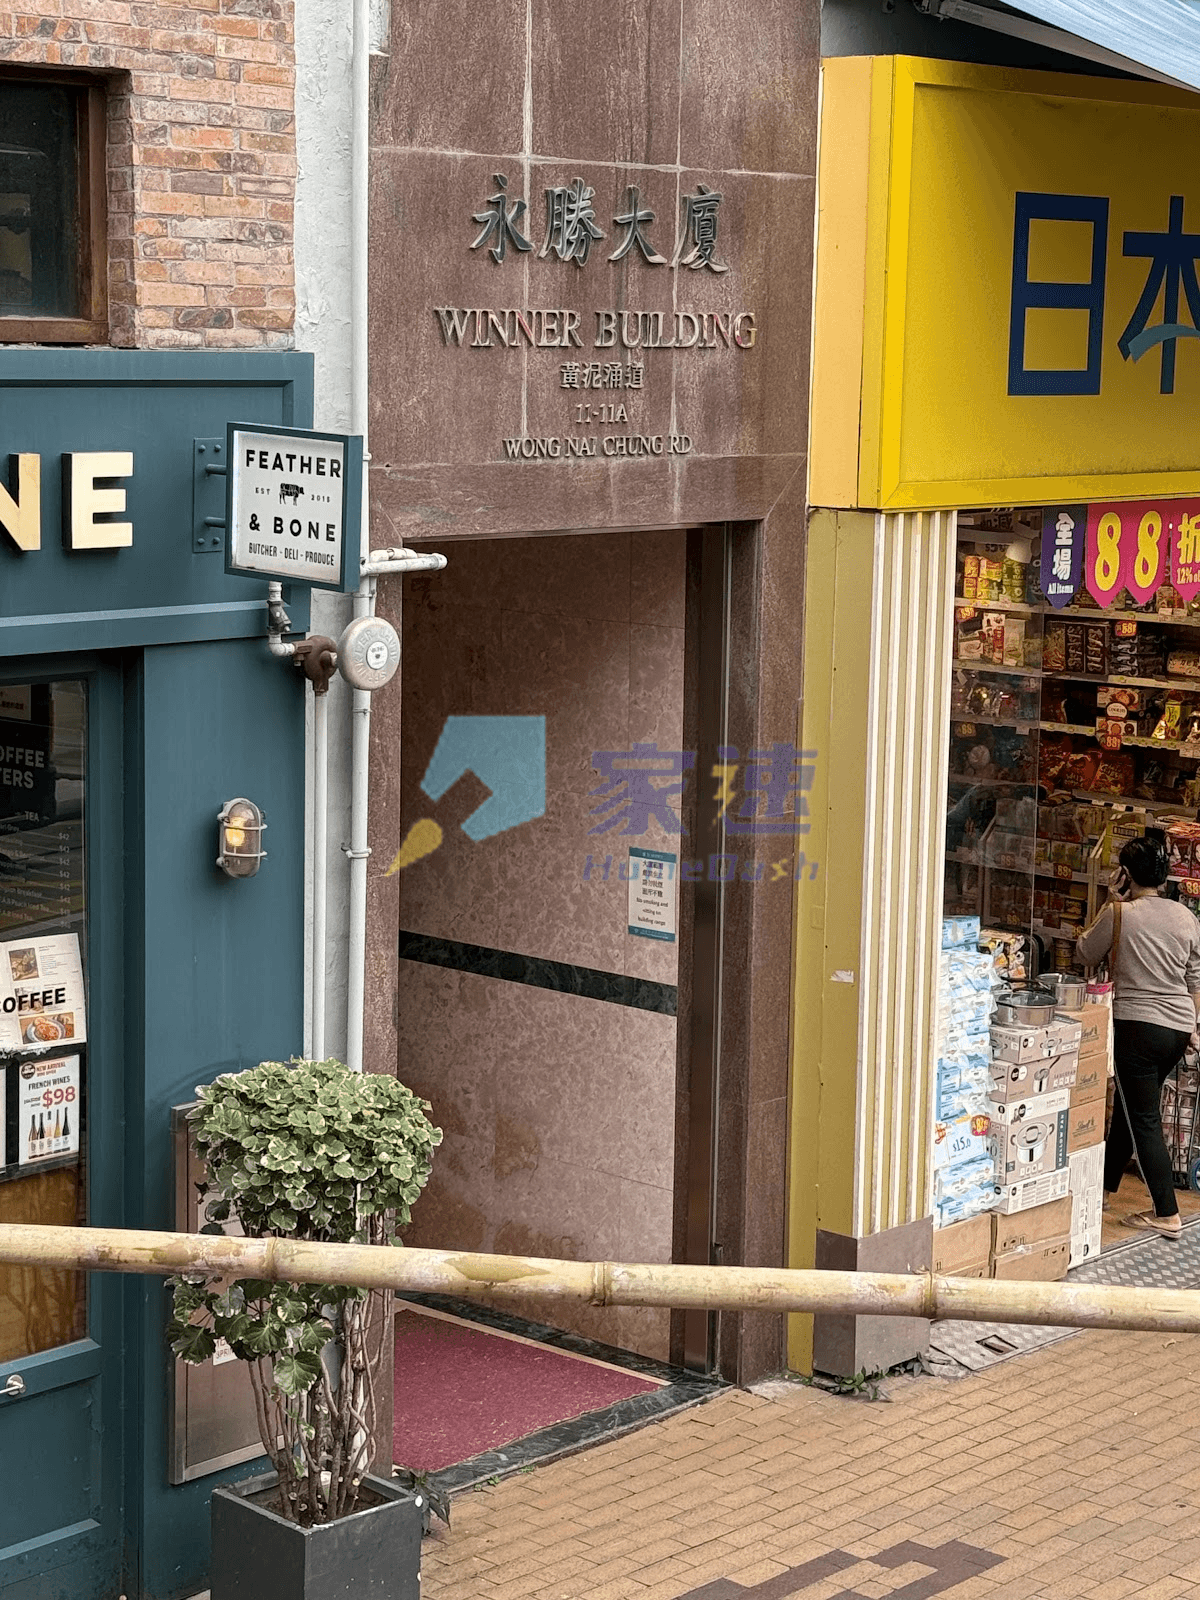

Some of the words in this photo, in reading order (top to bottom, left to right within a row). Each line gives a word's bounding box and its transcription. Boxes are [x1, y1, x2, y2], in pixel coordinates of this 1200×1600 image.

[469, 173, 728, 272] 永勝大廈
[1007, 191, 1200, 396] 日本
[434, 305, 584, 347] WINNER
[594, 309, 757, 349] BUILDING
[559, 362, 645, 389] 黃泥涌道
[575, 403, 628, 423] 11-11A
[503, 437, 561, 458] WONG
[565, 437, 597, 457] NAI
[603, 435, 664, 456] CHUNG
[669, 435, 693, 454] RD
[246, 449, 341, 478] FEATHER
[255, 487, 271, 495] EST
[249, 513, 260, 532] &
[273, 516, 336, 542] BONE
[249, 542, 277, 557] BUTCHER
[284, 547, 299, 561] DELI
[305, 552, 335, 566] PRODUCE
[1052, 513, 1075, 580] 全場
[1048, 583, 1057, 595] All
[25, 811, 39, 821] TEA
[0, 987, 66, 1013] OFFEE
[29, 1079, 51, 1091] FRENCH
[52, 1075, 71, 1086] WINES
[42, 1085, 76, 1110] $98
